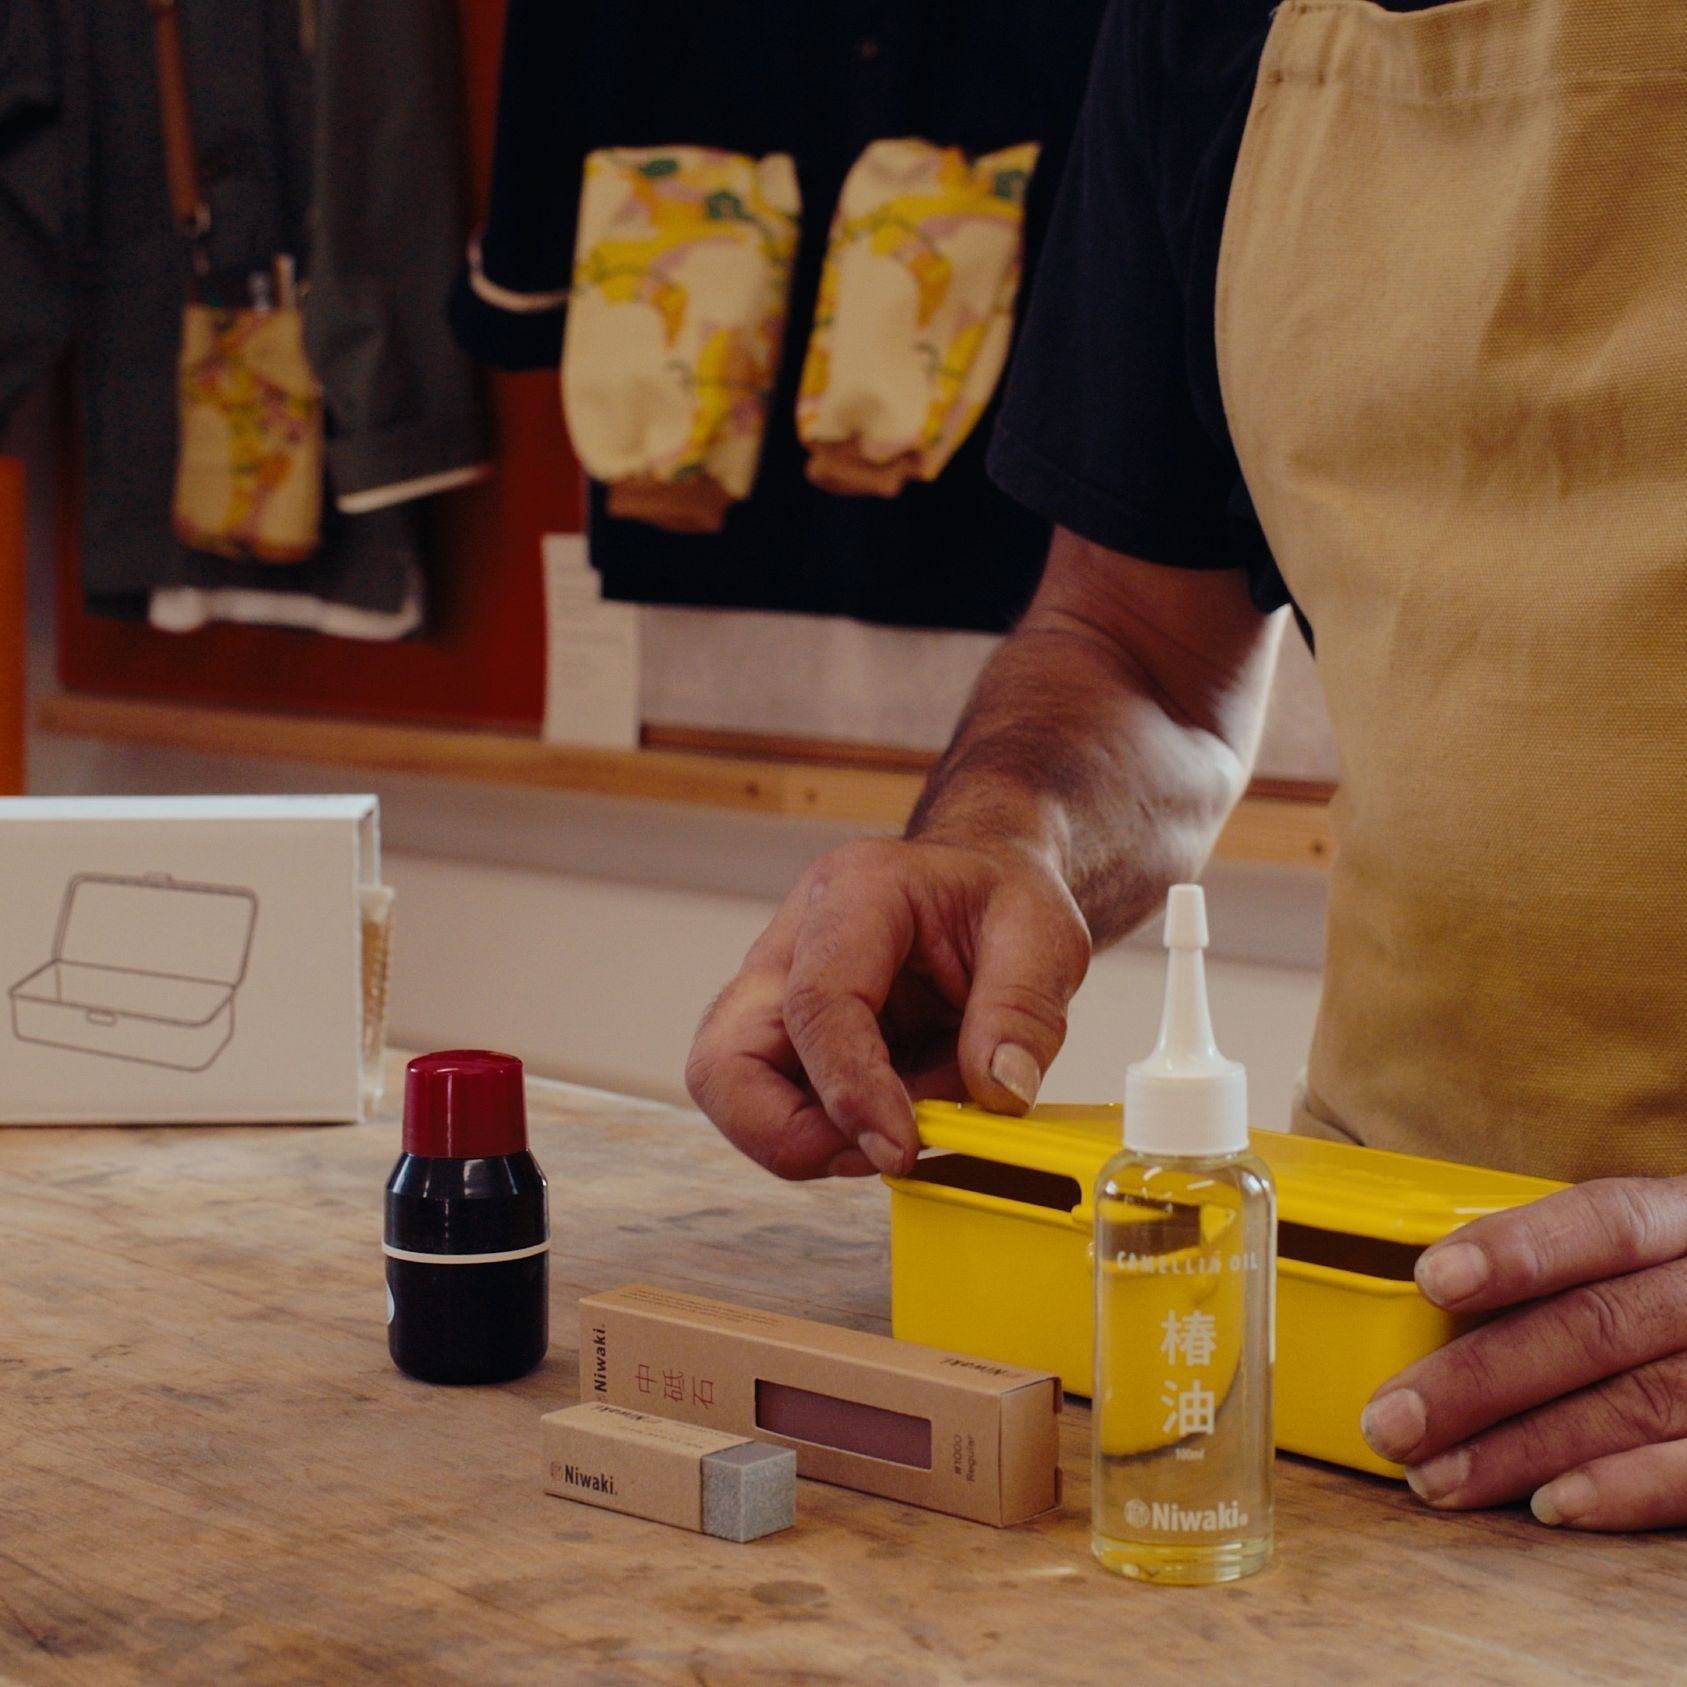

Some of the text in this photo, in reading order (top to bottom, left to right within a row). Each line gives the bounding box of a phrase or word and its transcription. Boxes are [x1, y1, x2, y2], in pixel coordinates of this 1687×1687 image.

[1116, 1250, 1258, 1275] CAMELLIA OIL
[1160, 1309, 1216, 1436] 椿油
[966, 1434, 976, 1482] Regular
